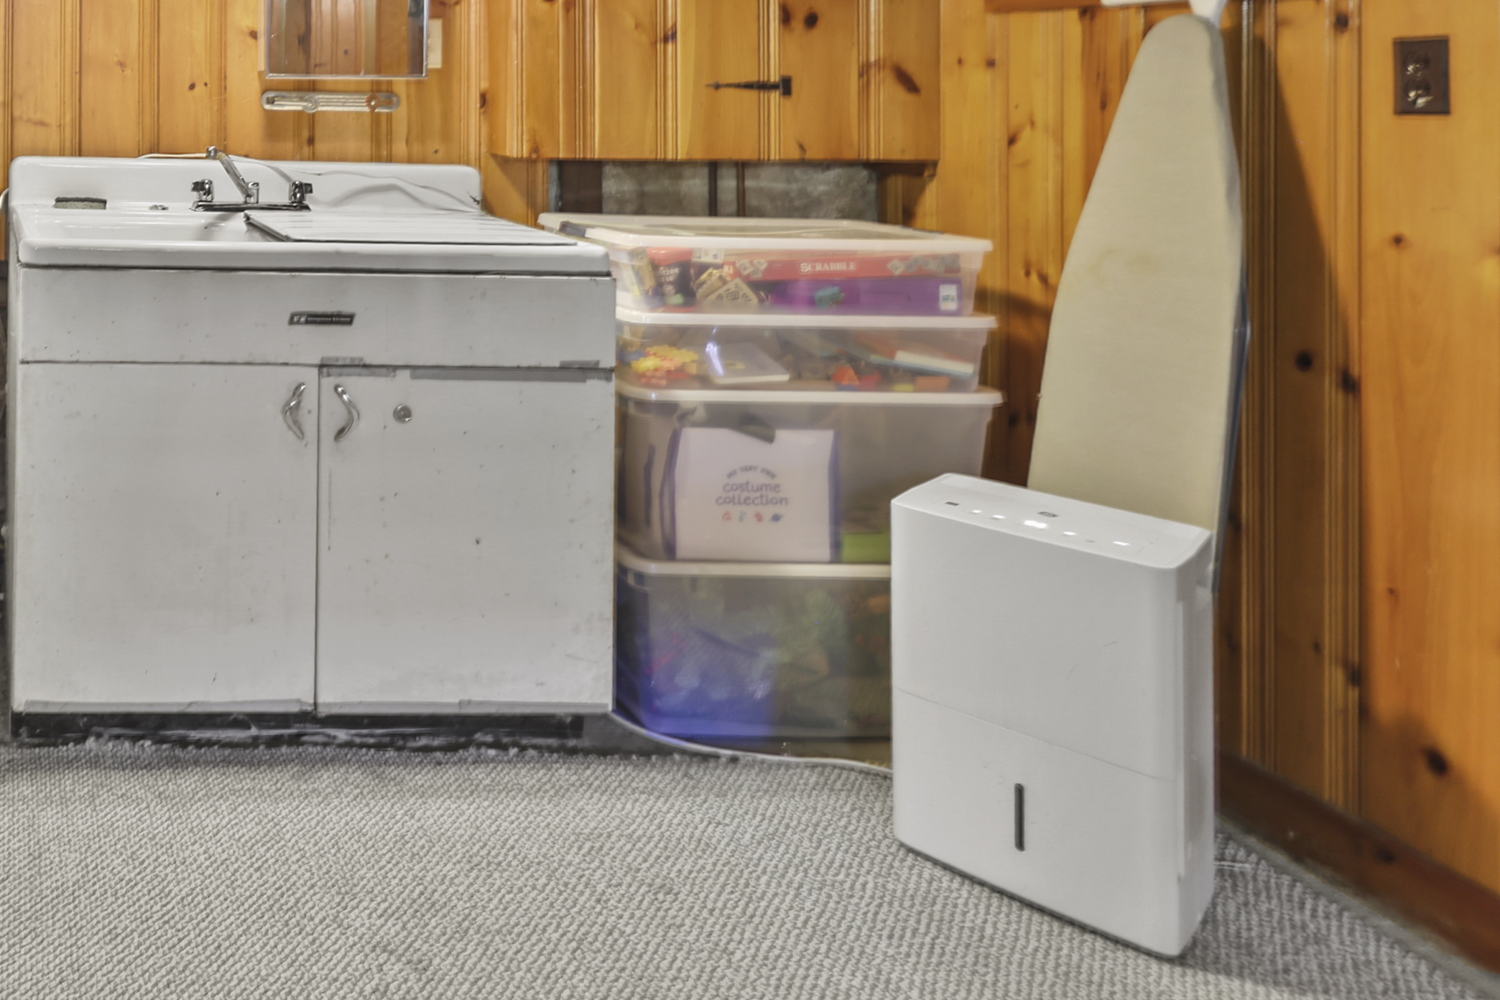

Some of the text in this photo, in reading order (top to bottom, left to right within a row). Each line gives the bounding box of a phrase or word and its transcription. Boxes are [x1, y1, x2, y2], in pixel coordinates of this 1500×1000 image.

[800, 261, 857, 274] SCRABBLE
[760, 467, 777, 479] OWN
[722, 480, 781, 493] costume
[715, 493, 789, 506] collection
